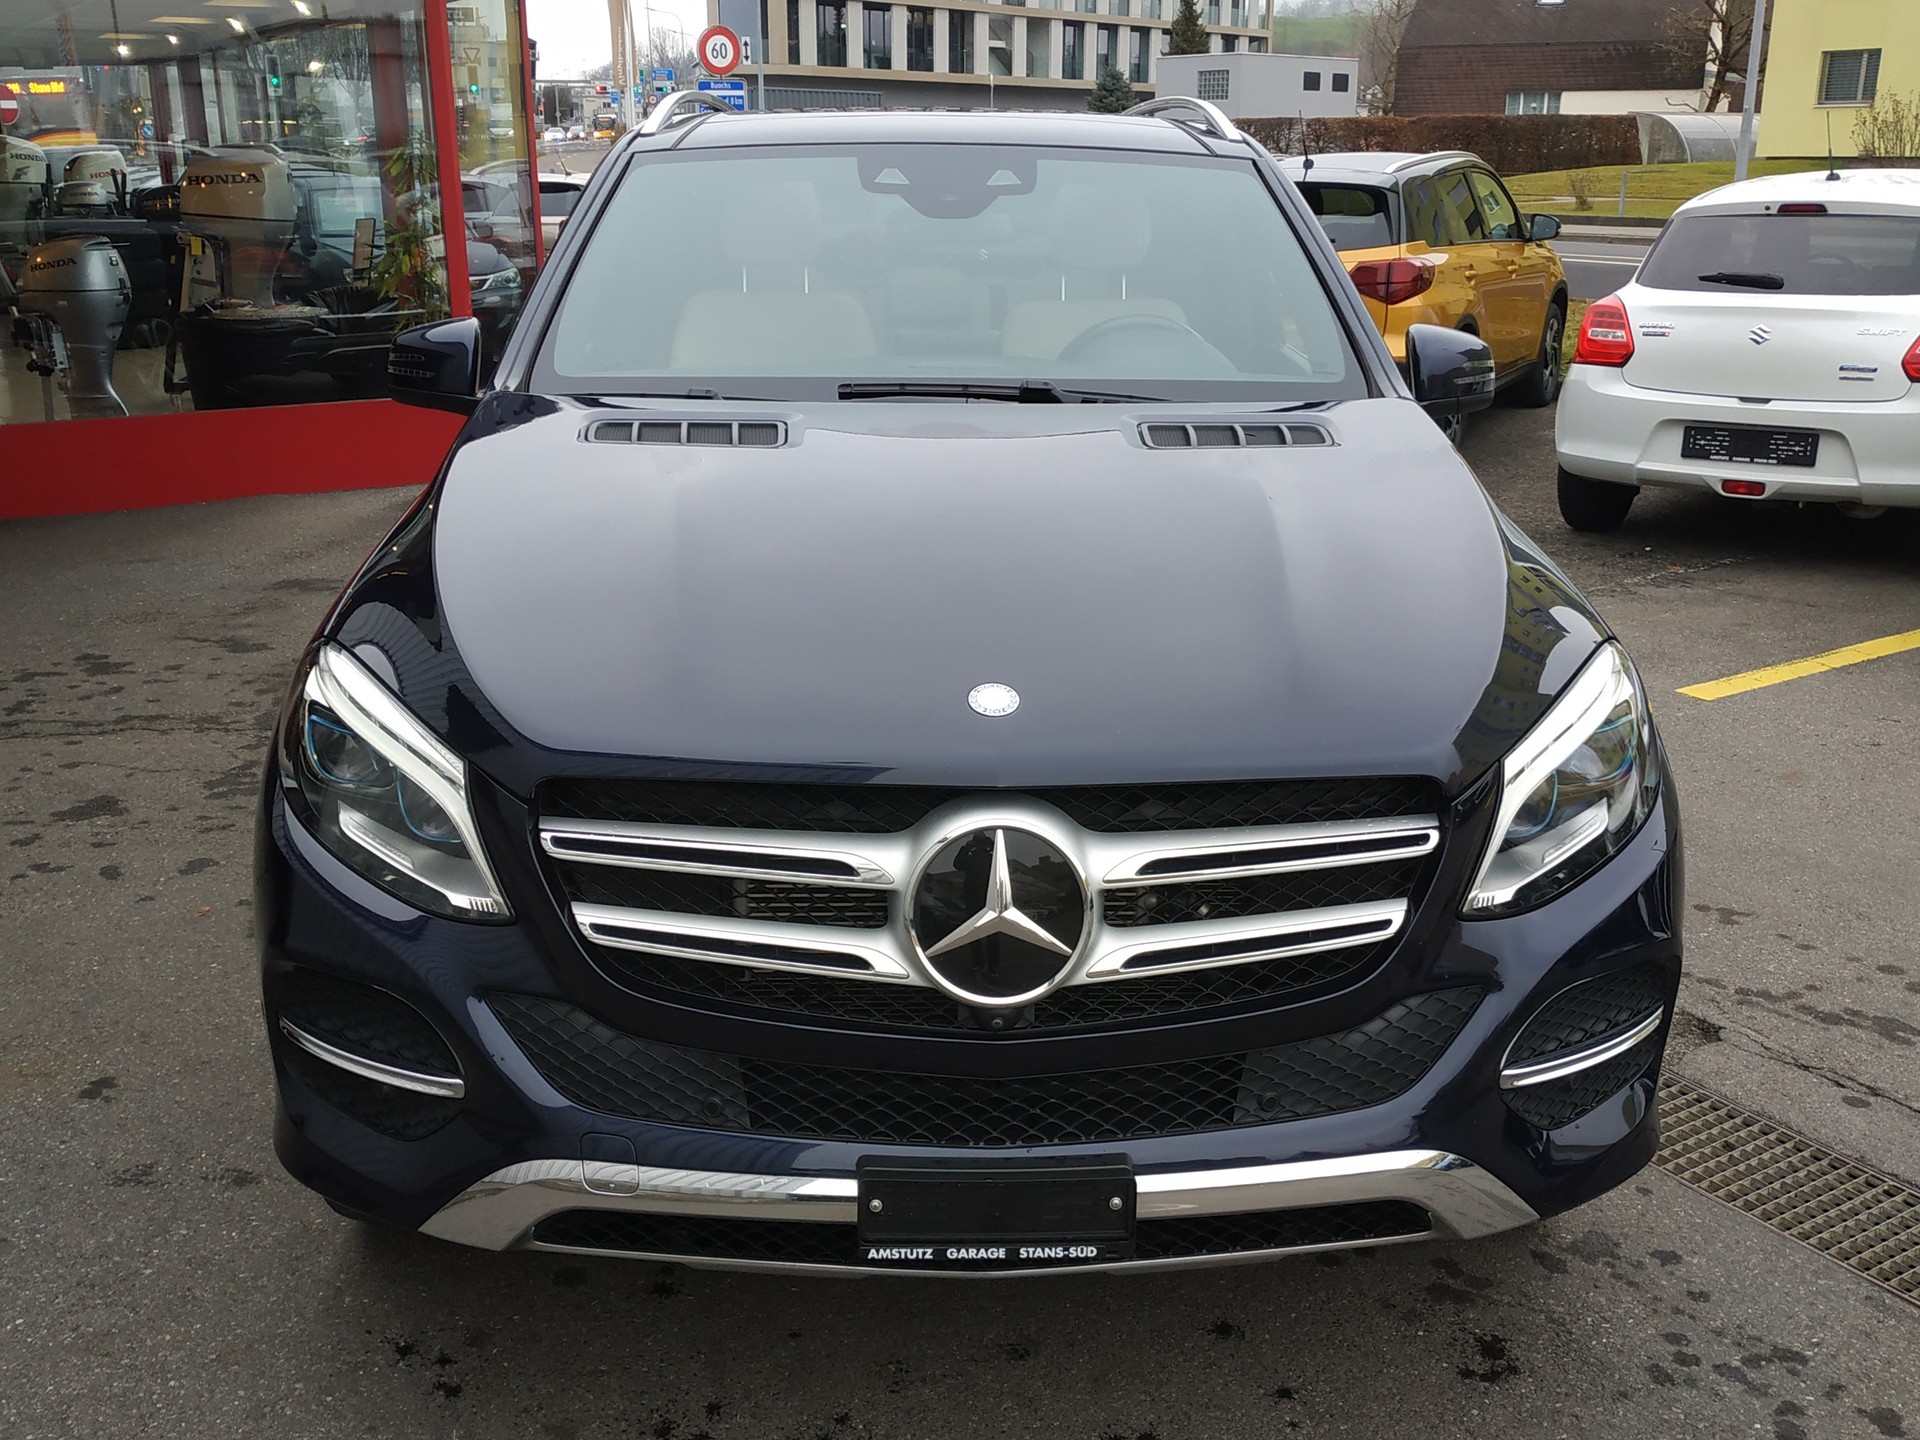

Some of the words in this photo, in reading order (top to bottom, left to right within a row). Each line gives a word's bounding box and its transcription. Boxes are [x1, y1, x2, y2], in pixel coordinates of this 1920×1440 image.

[711, 42, 728, 60] 60
[710, 81, 732, 90] Buochs
[187, 173, 262, 186] HONDA
[30, 257, 77, 272] HONDA
[1856, 327, 1907, 336] SWIFT
[867, 1248, 933, 1260] AMSTUTZ
[946, 1247, 1006, 1260] GARAGE
[1019, 1245, 1097, 1259] STANS-SÜD
